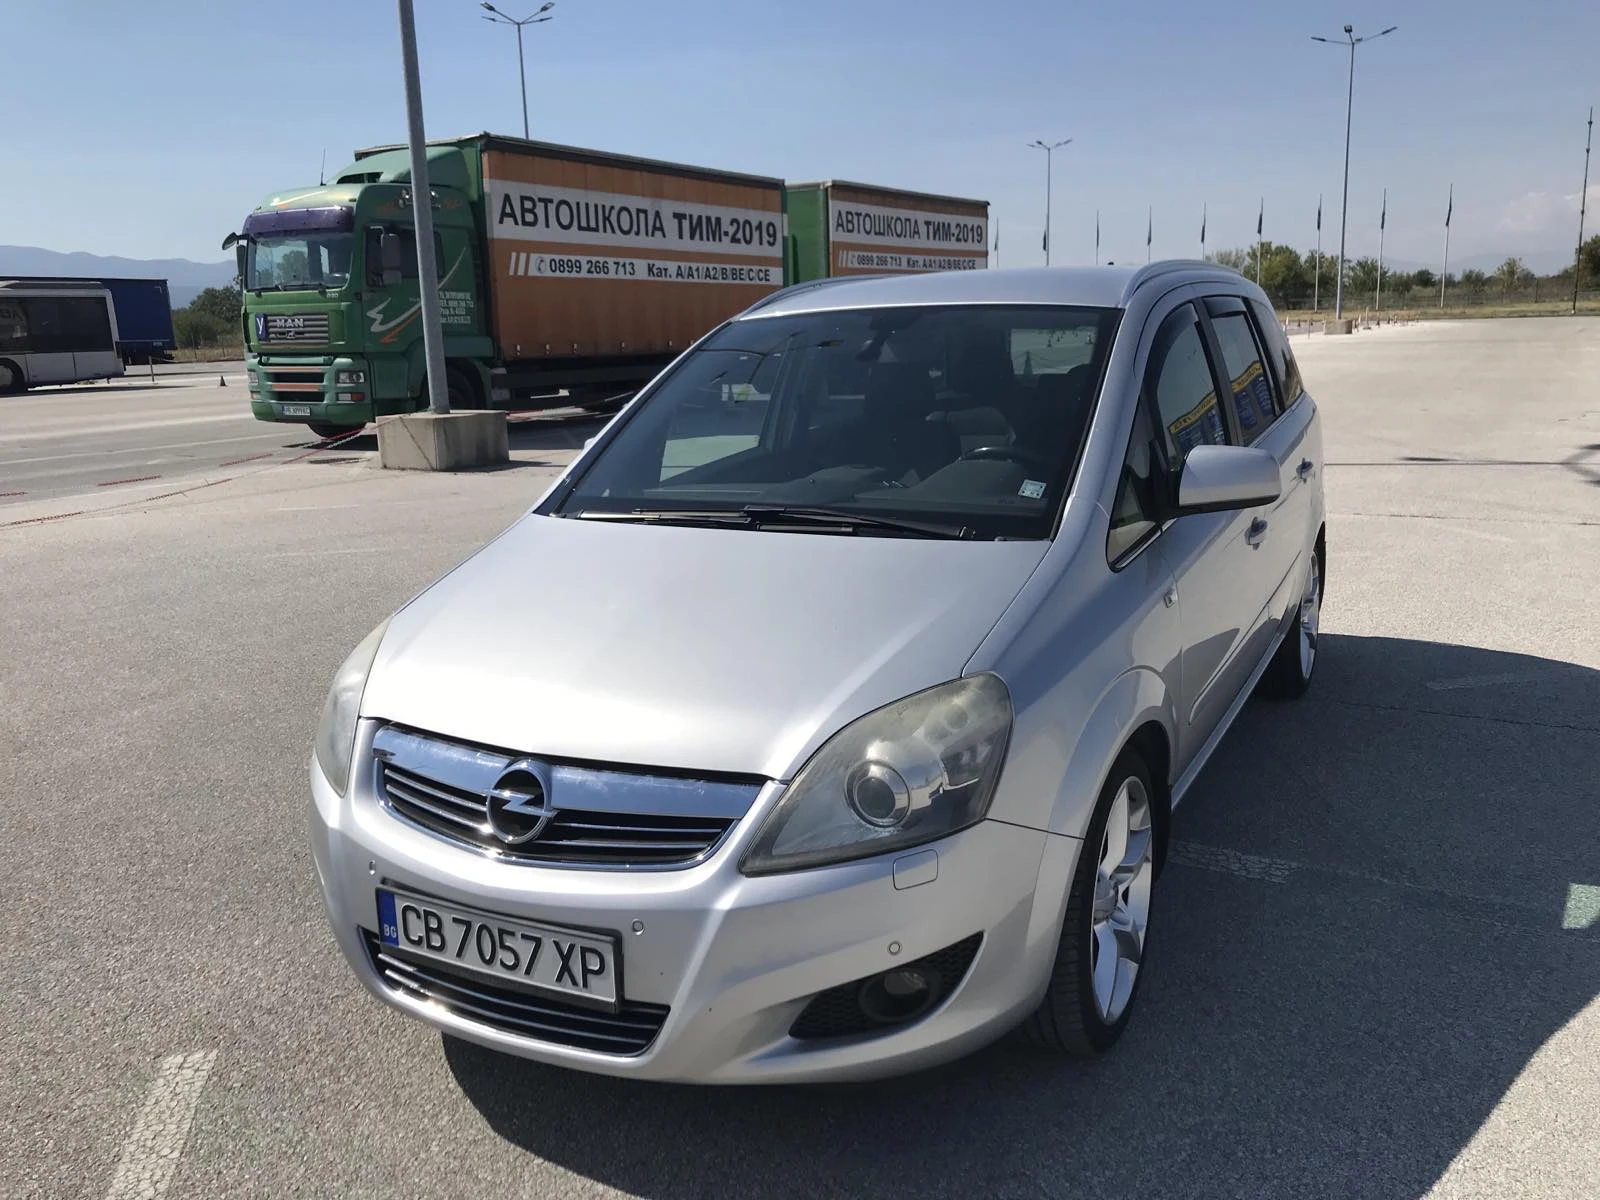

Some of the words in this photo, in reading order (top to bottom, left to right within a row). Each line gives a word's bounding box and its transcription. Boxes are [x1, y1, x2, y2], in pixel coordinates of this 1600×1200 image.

[498, 193, 667, 238] АВТОШКОЛА
[673, 212, 777, 247] ТИМ-2019
[836, 210, 920, 239] АВТОШКОЛА
[924, 220, 983, 244] ТИМ-2019
[549, 258, 582, 274] 0899
[586, 259, 609, 275] 266
[613, 261, 635, 276] 713
[648, 262, 671, 279] Кат.
[857, 254, 874, 266] 0899
[876, 255, 889, 267] 266
[276, 318, 304, 328] MAN
[383, 924, 397, 938] BG
[401, 904, 446, 952] CB
[452, 916, 542, 976] 7057
[552, 938, 605, 989] XP
